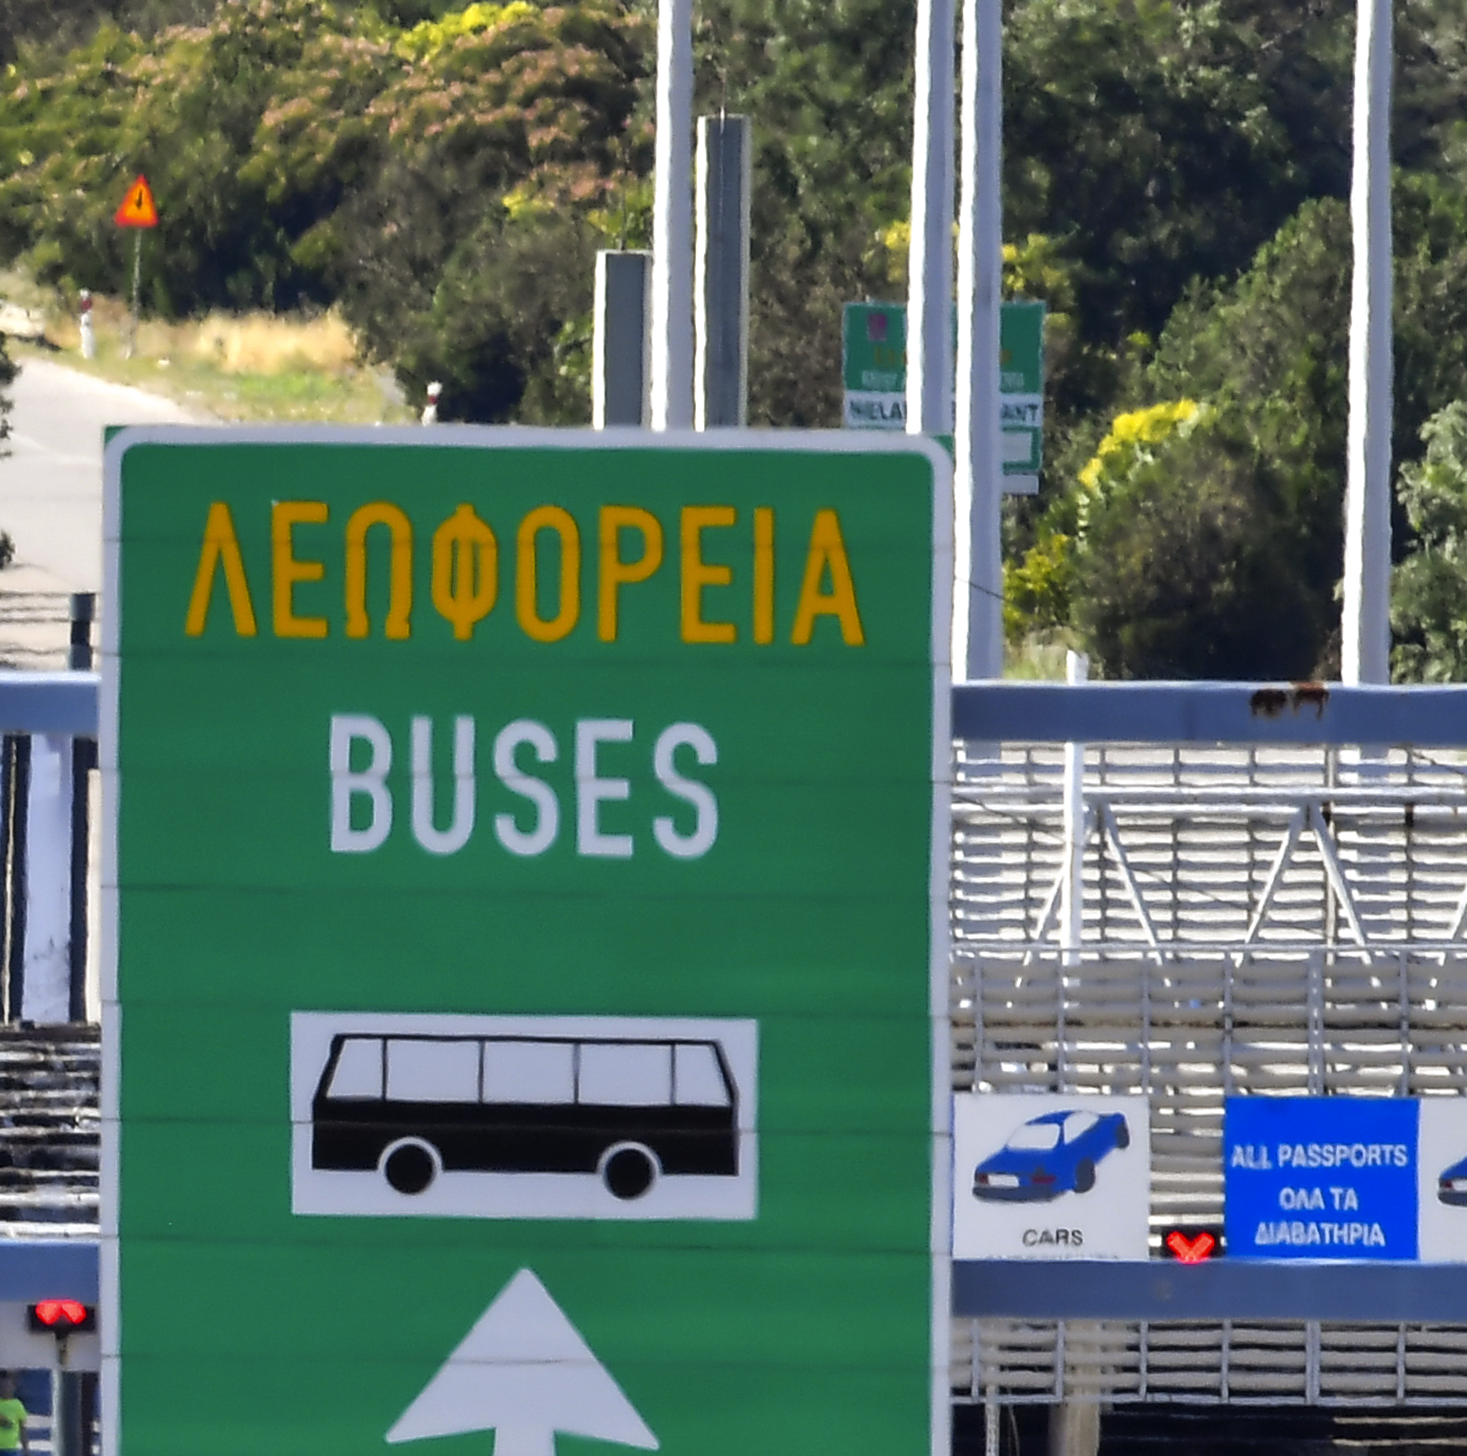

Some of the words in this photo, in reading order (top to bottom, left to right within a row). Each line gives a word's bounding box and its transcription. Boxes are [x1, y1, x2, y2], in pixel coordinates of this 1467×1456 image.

[184, 499, 865, 646] ΛΕΩΦΟΡΕΙΑ
[328, 713, 719, 859] BUSES
[1231, 1145, 1274, 1169] ALL
[1278, 1144, 1409, 1168] PASSPORTS
[1279, 1188, 1327, 1211] ΟΛΑ
[1330, 1188, 1359, 1211] ΤΑ
[1022, 1228, 1084, 1247] CARS
[1254, 1222, 1386, 1247] ΔΙΑΒΑΤΗΡΙΑ
